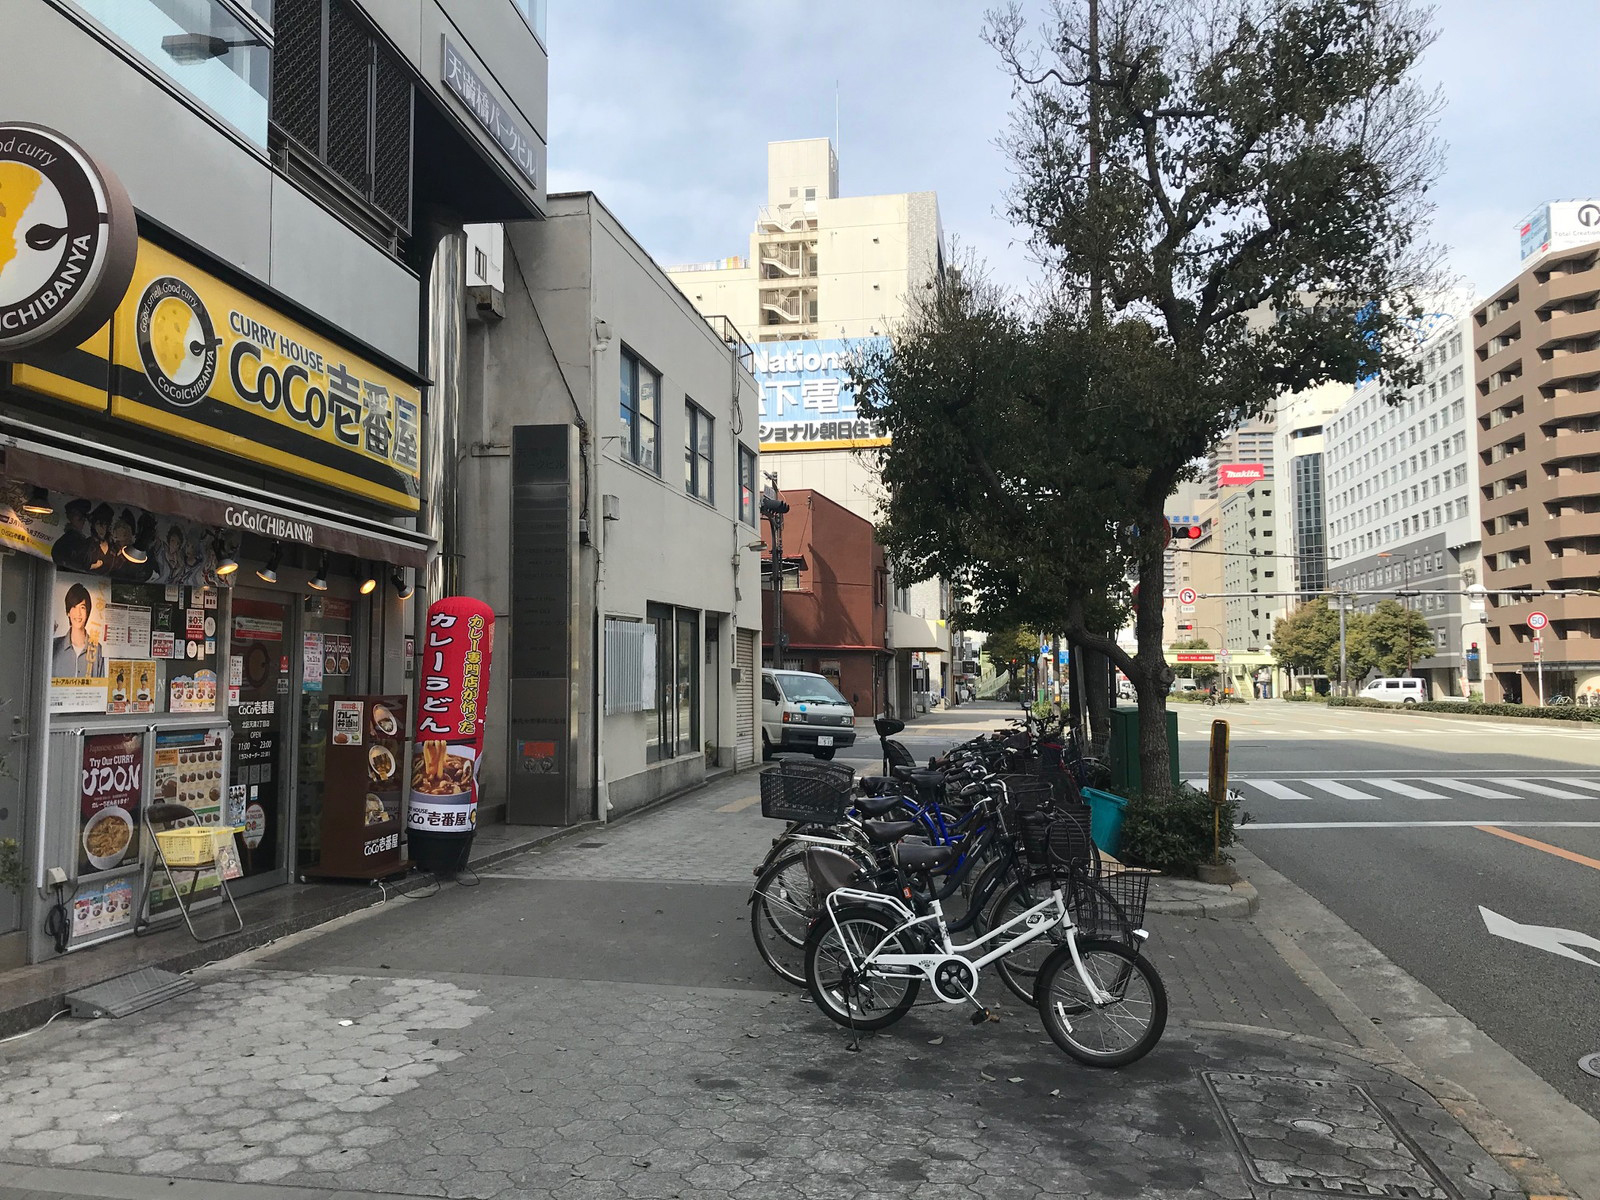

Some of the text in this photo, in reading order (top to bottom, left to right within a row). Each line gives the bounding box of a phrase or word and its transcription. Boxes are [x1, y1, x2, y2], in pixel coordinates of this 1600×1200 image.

[448, 48, 536, 176] 天満橋パークビル
[17, 142, 57, 167] curry
[0, 234, 91, 331] CHIBANYA
[140, 302, 150, 333] Good
[162, 282, 181, 293] Good
[181, 288, 198, 307] curry
[229, 311, 324, 373] CURRY HOUSE
[158, 350, 214, 400] CoCoICHIBANYA
[753, 350, 854, 374] Nation
[225, 507, 314, 543] CoCoICHIBANYA
[1531, 616, 1544, 625] 50
[420, 612, 458, 733] カレーうどん
[458, 614, 485, 734] カレー専門店が作った
[238, 701, 274, 714] CoCo壱番屋
[338, 711, 358, 719] カレー
[90, 754, 134, 768] Try Our CURRY
[82, 763, 140, 796] UDON
[407, 811, 467, 827] oCo壱番屋
[363, 833, 398, 856] CoCo壱番屋
